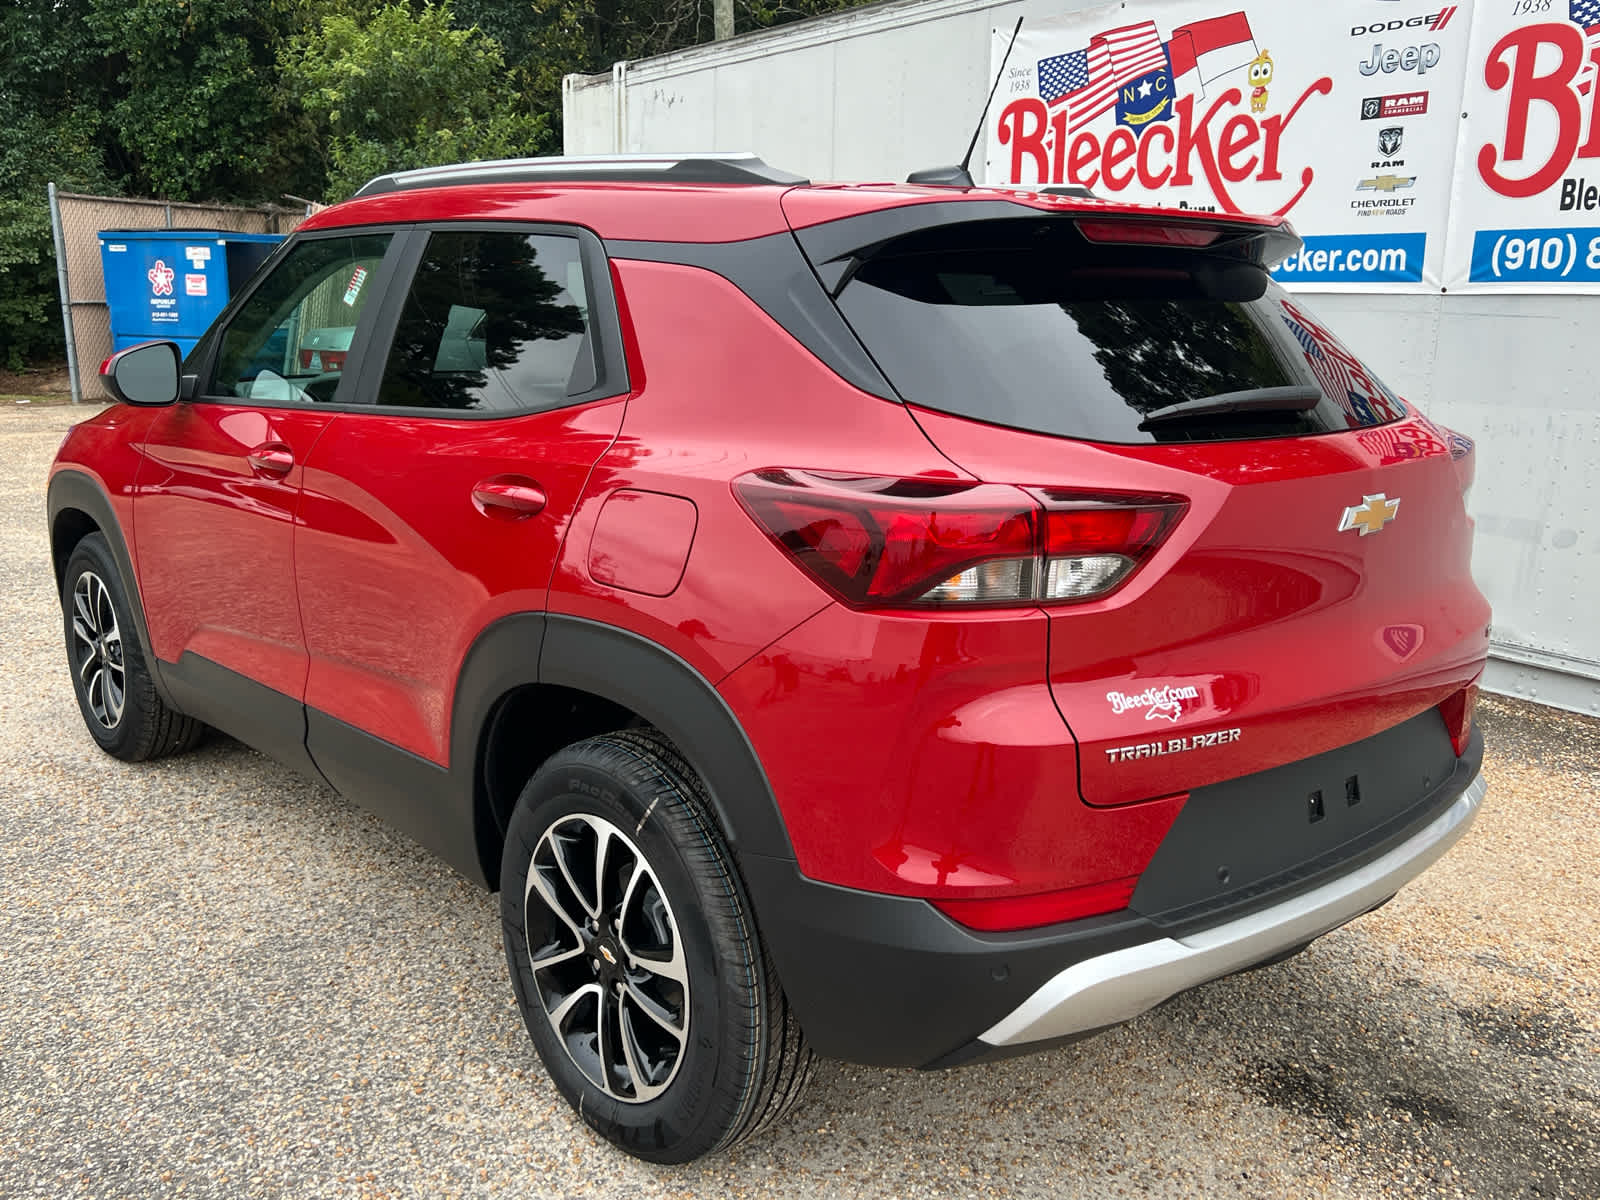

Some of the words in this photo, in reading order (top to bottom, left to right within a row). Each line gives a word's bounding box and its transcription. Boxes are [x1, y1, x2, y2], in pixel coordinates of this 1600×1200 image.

[1512, 0, 1552, 16] 1938
[1350, 13, 1441, 37] DODGE
[1359, 43, 1441, 76] Jeep
[1009, 67, 1032, 79] Since
[1010, 79, 1031, 93] 1938
[1124, 87, 1135, 104] N
[1155, 76, 1167, 92] C
[1384, 106, 1424, 115] COMMERCIAL
[1385, 95, 1425, 107] RAM
[998, 77, 1333, 216] Bleecker
[1371, 160, 1405, 168] RAM
[1350, 198, 1417, 209] CHEVROLET
[1560, 178, 1600, 211] Ble
[1357, 209, 1371, 217] FIND
[1385, 208, 1407, 216] ROADS
[1491, 233, 1577, 277] (910)
[1106, 684, 1199, 715] Bleecker.com
[1105, 728, 1242, 764] TRAILBLAZER
